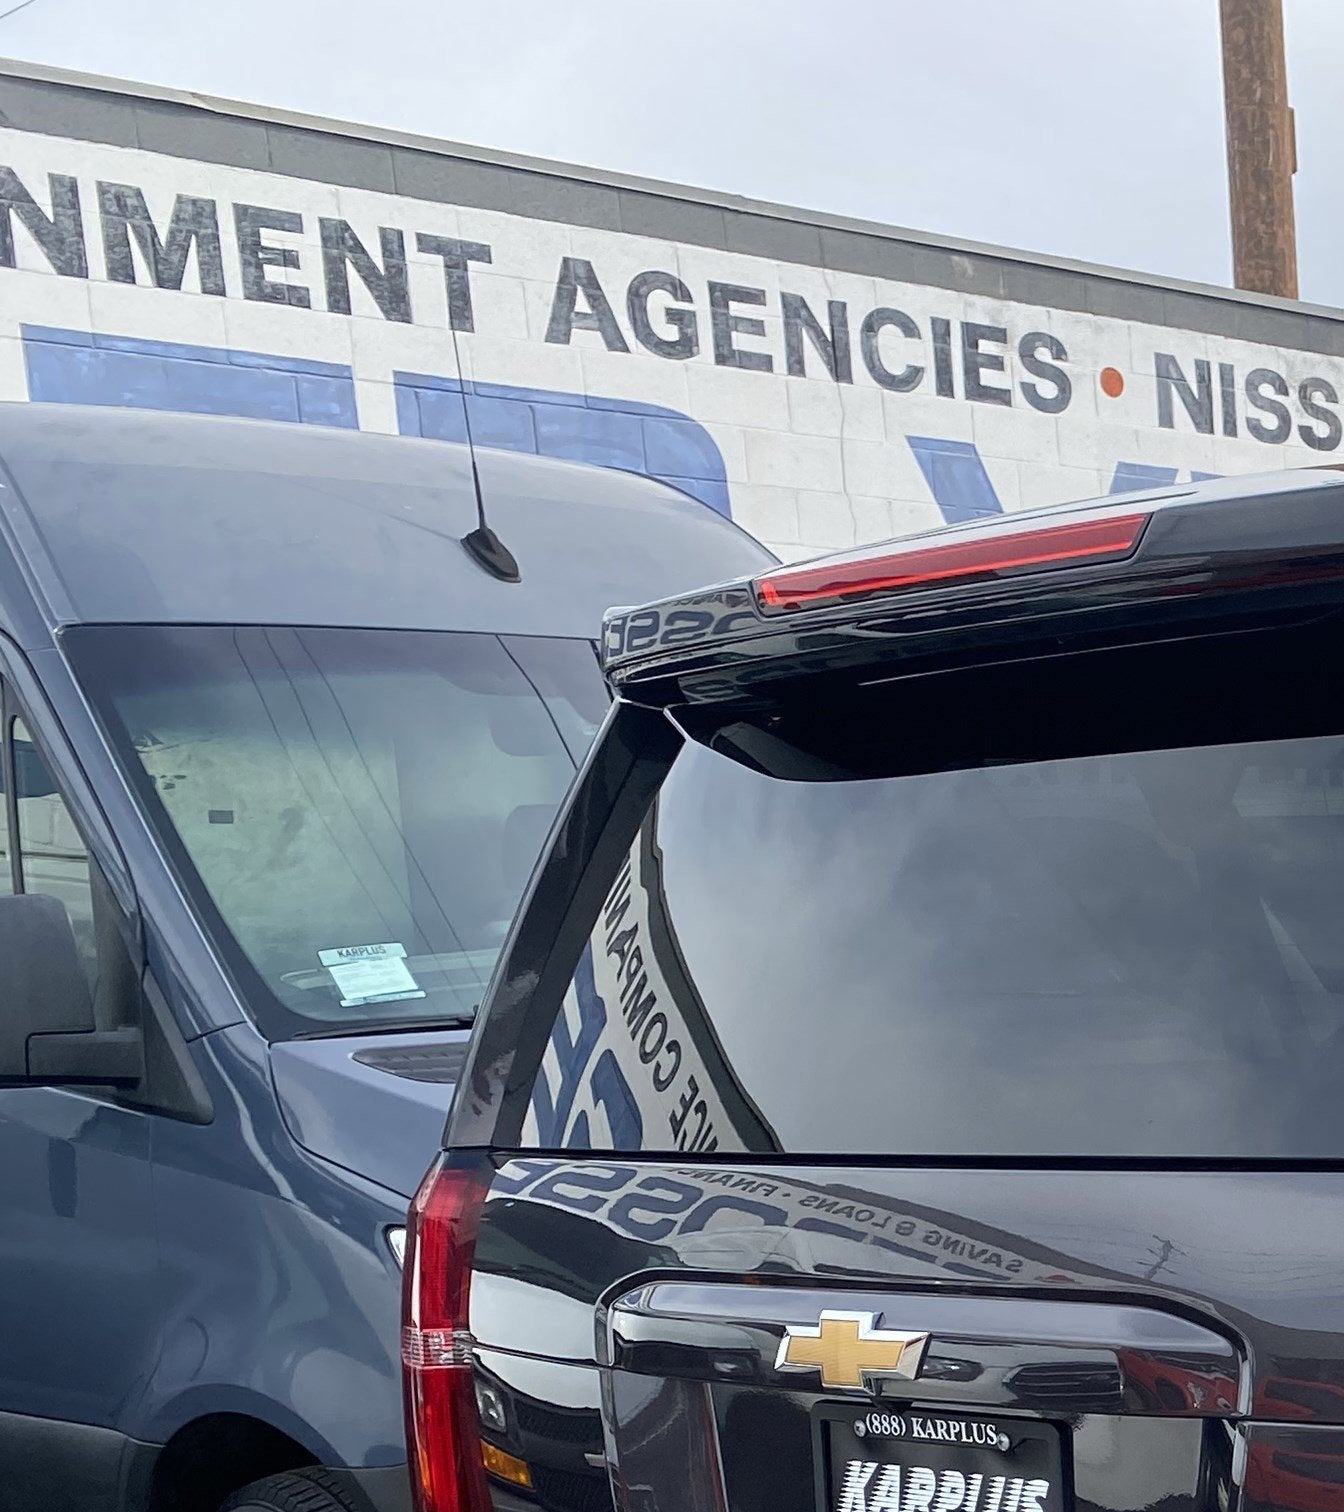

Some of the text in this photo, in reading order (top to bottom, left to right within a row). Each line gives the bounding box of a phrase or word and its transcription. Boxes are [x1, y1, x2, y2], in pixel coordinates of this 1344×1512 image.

[544, 256, 1073, 414] AGENCIES
[337, 945, 387, 958] KARPLUS
[865, 1412, 998, 1446] (888) KARPLUS
